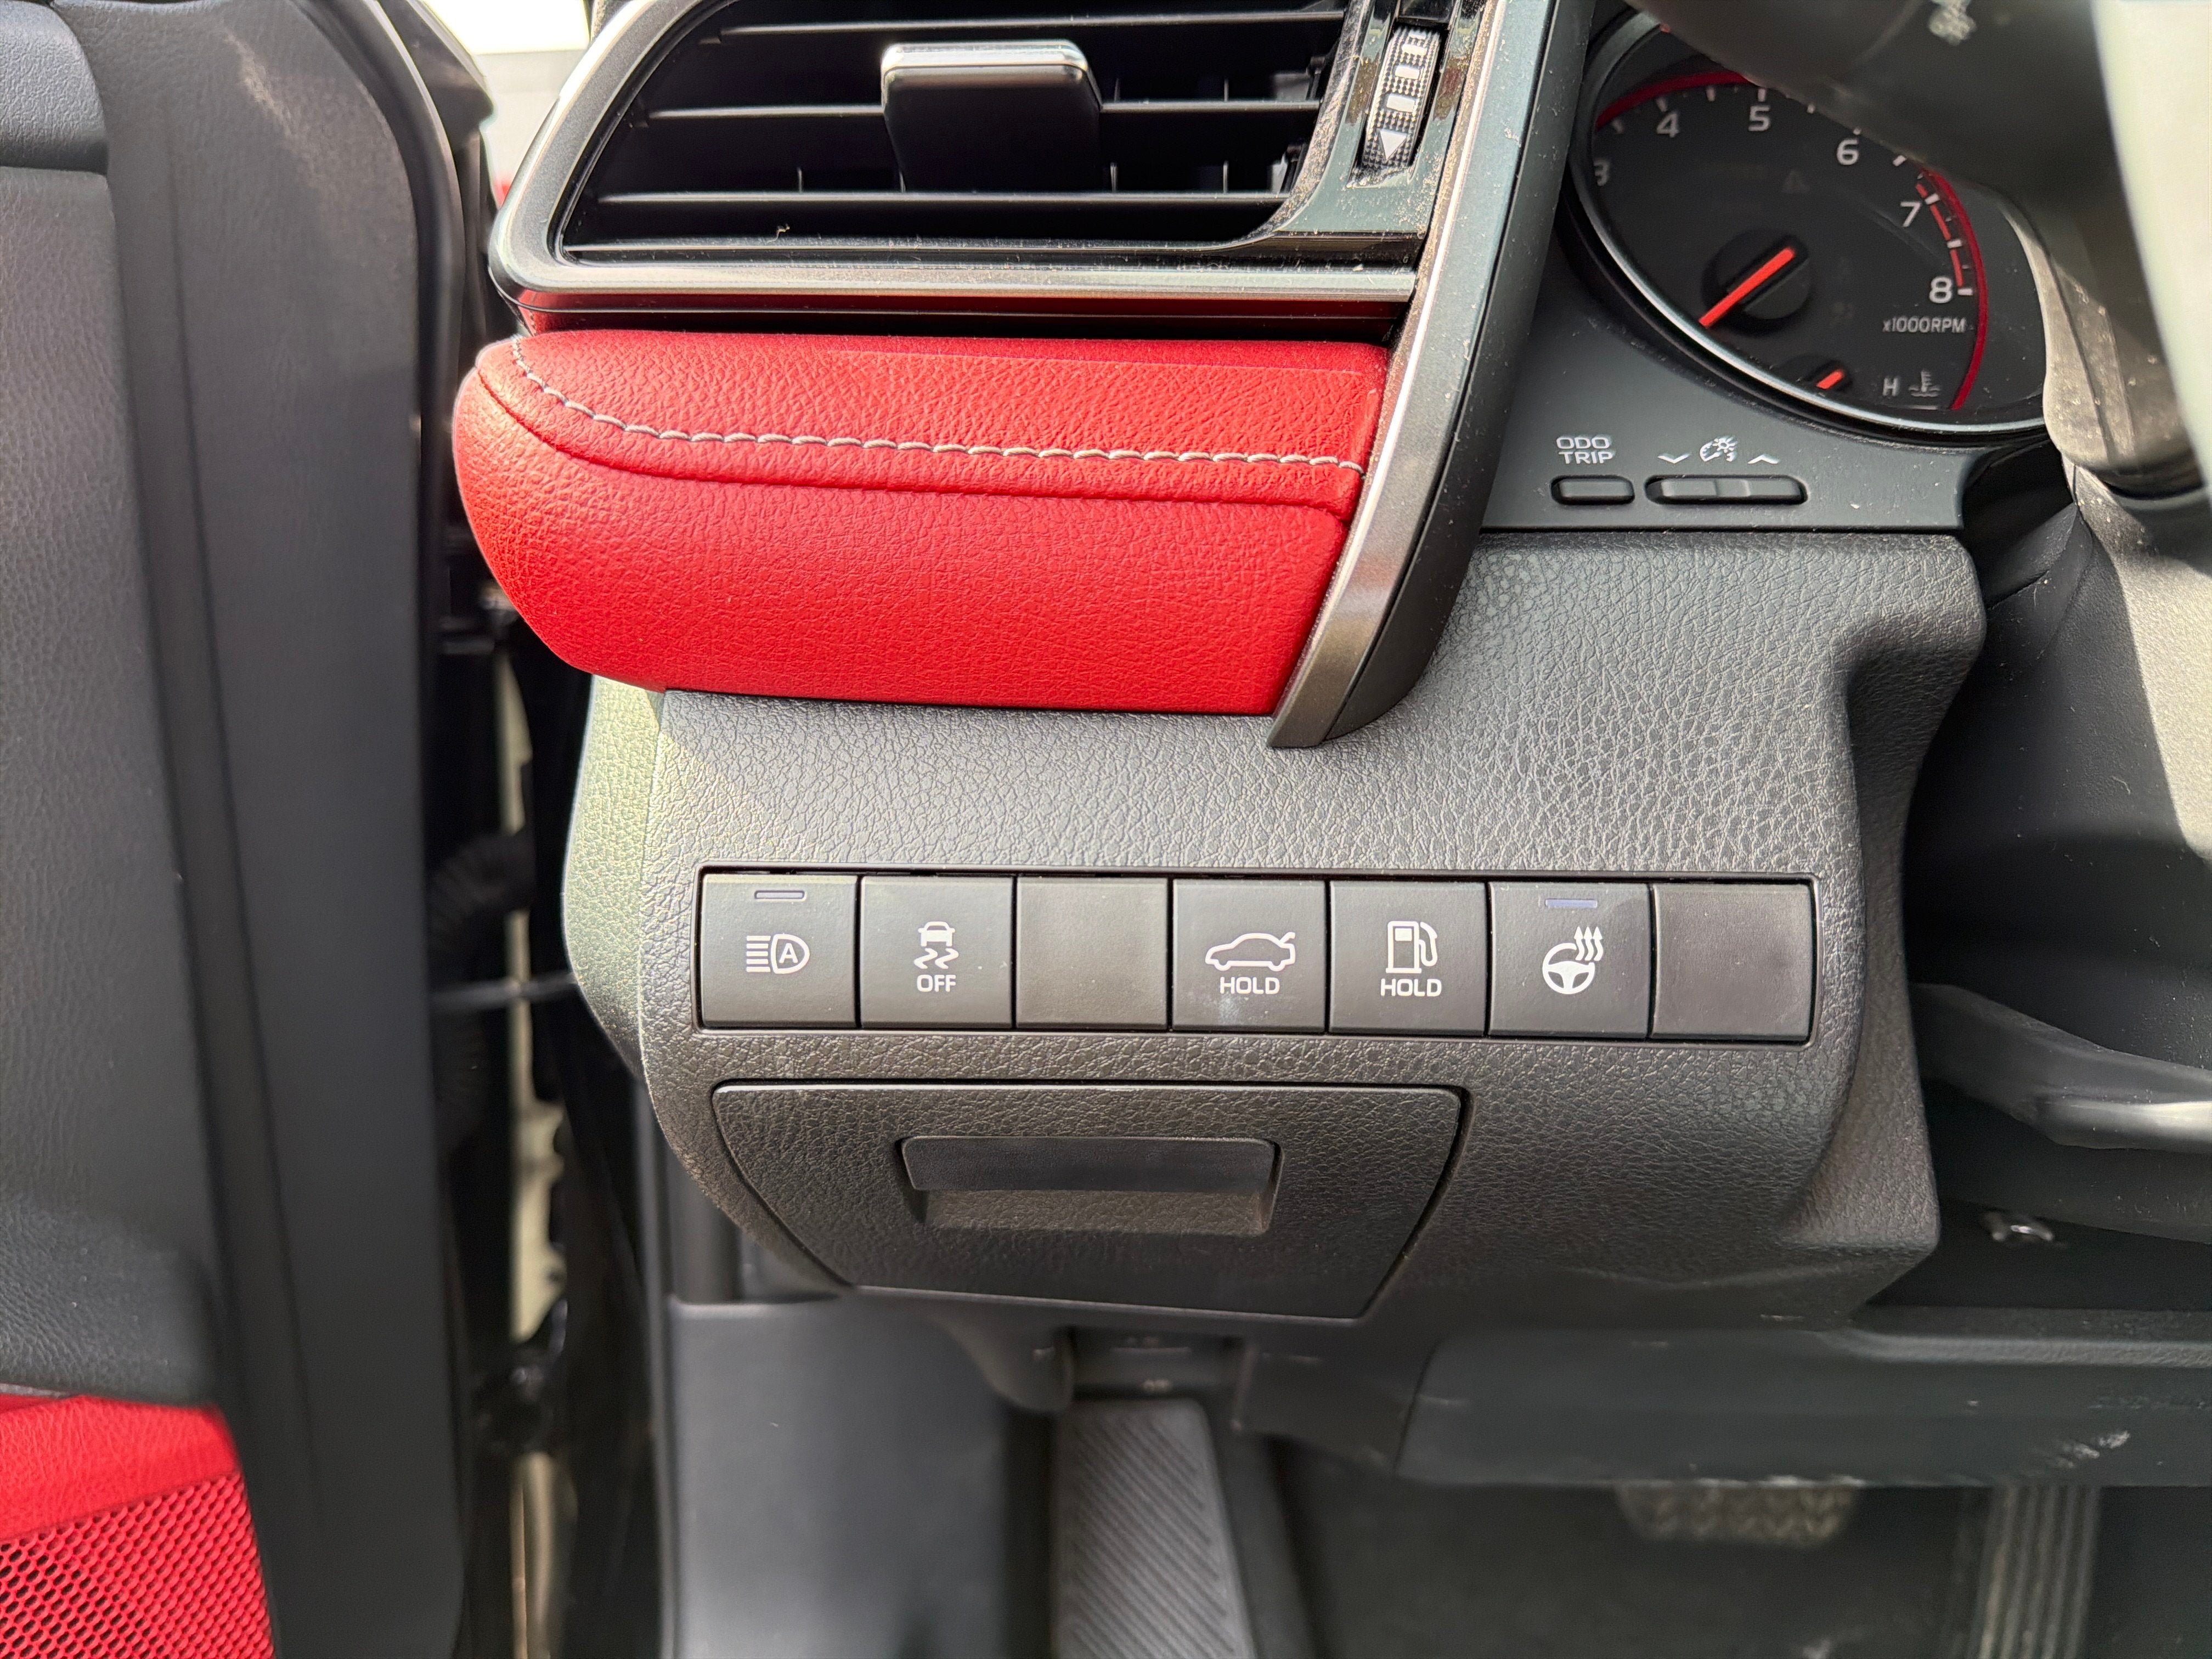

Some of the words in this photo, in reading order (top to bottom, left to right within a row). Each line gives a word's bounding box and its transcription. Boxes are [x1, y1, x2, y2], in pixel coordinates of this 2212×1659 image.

[1656, 111, 1680, 138] 4
[1748, 105, 1771, 132] 5
[1836, 138, 1860, 166] 6
[1593, 157, 1611, 187] 3
[1900, 201, 1922, 228] 7
[1928, 276, 1953, 303] 8
[1882, 376, 1900, 397] H
[1556, 436, 1611, 449] ODO
[1558, 450, 1614, 464] TRIP
[779, 943, 798, 964] A
[916, 974, 957, 992] OFF
[1220, 977, 1280, 995] HOLD
[1380, 979, 1443, 997] HOLD
